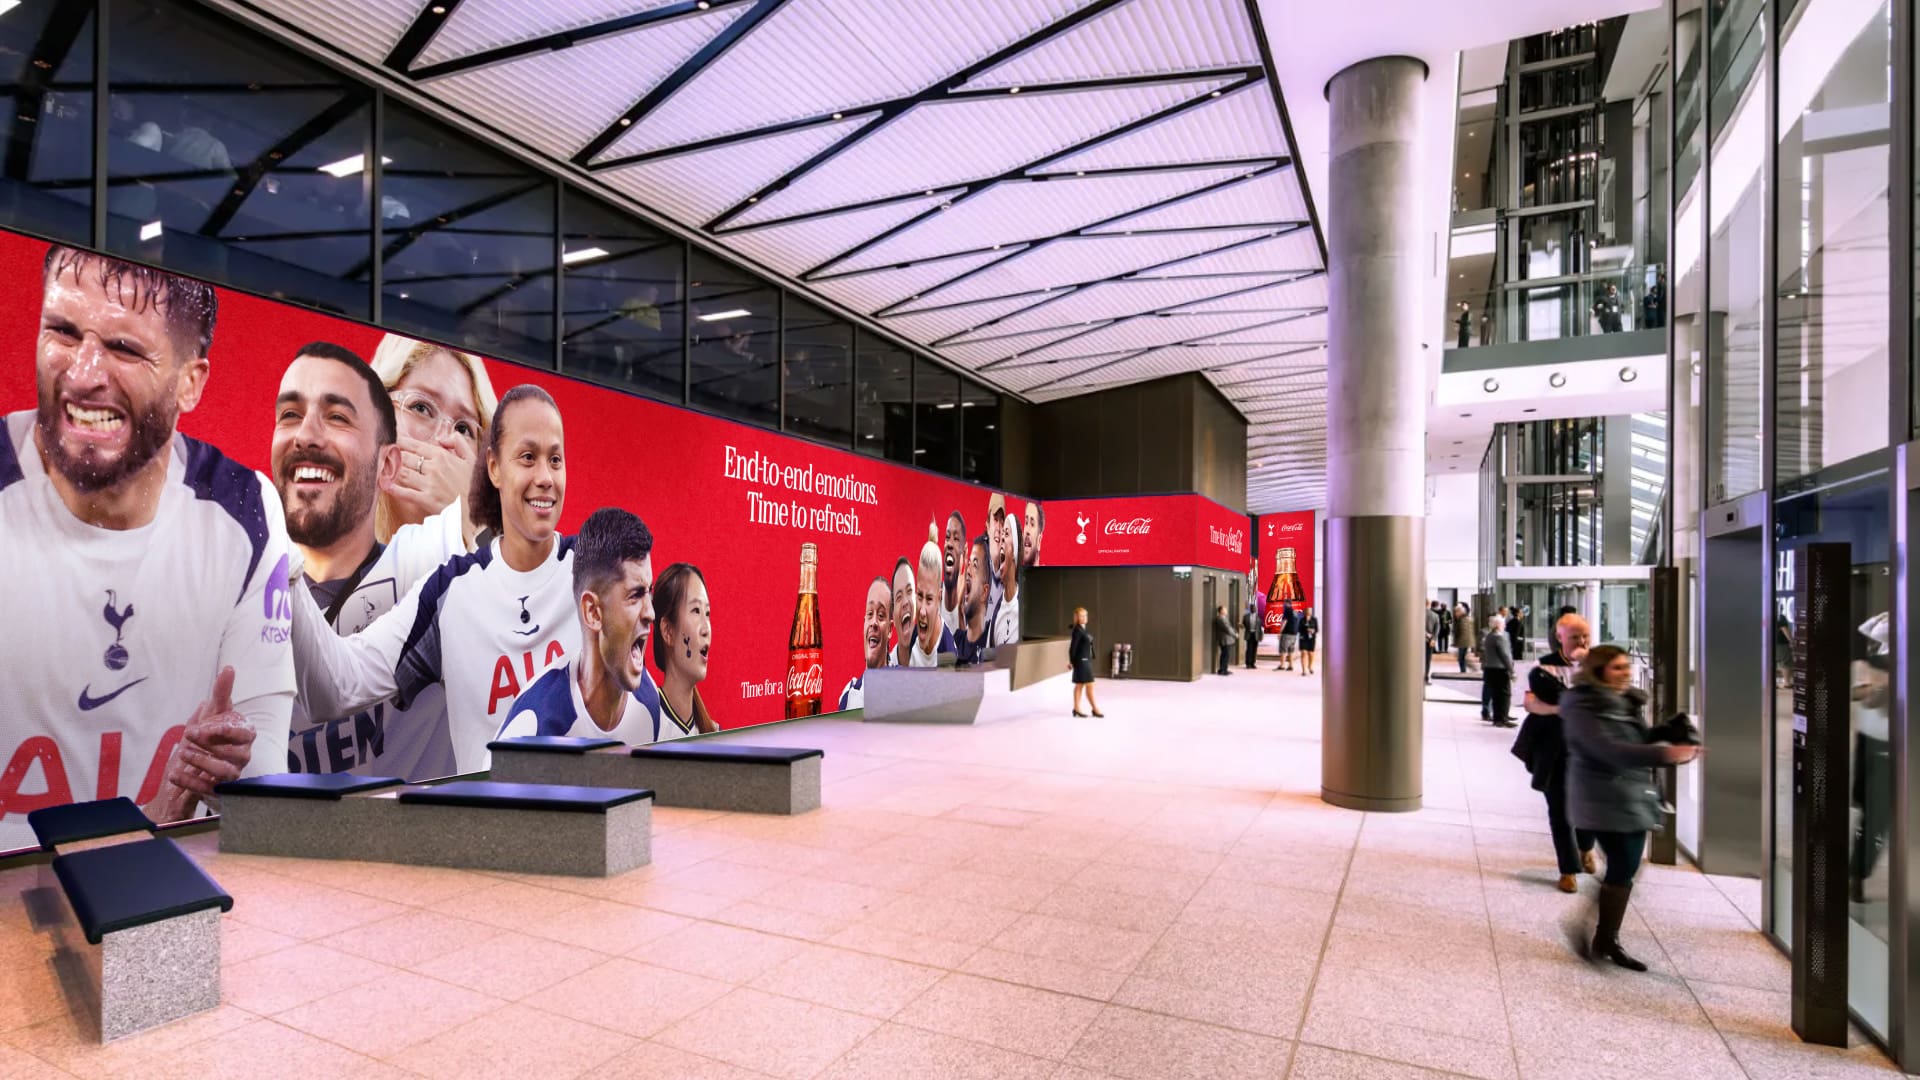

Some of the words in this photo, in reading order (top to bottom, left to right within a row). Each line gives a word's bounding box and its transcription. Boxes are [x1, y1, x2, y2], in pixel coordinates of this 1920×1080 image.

[724, 445, 813, 493] End-to-end
[815, 472, 878, 505] emotions.
[747, 491, 789, 527] Time
[791, 500, 807, 529] to
[809, 503, 862, 536] refresh.
[1104, 517, 1153, 535] Coca-Cola
[740, 681, 764, 699] Time
[763, 679, 777, 696] for
[777, 681, 783, 694] a
[786, 663, 823, 698] Coca-Cola
